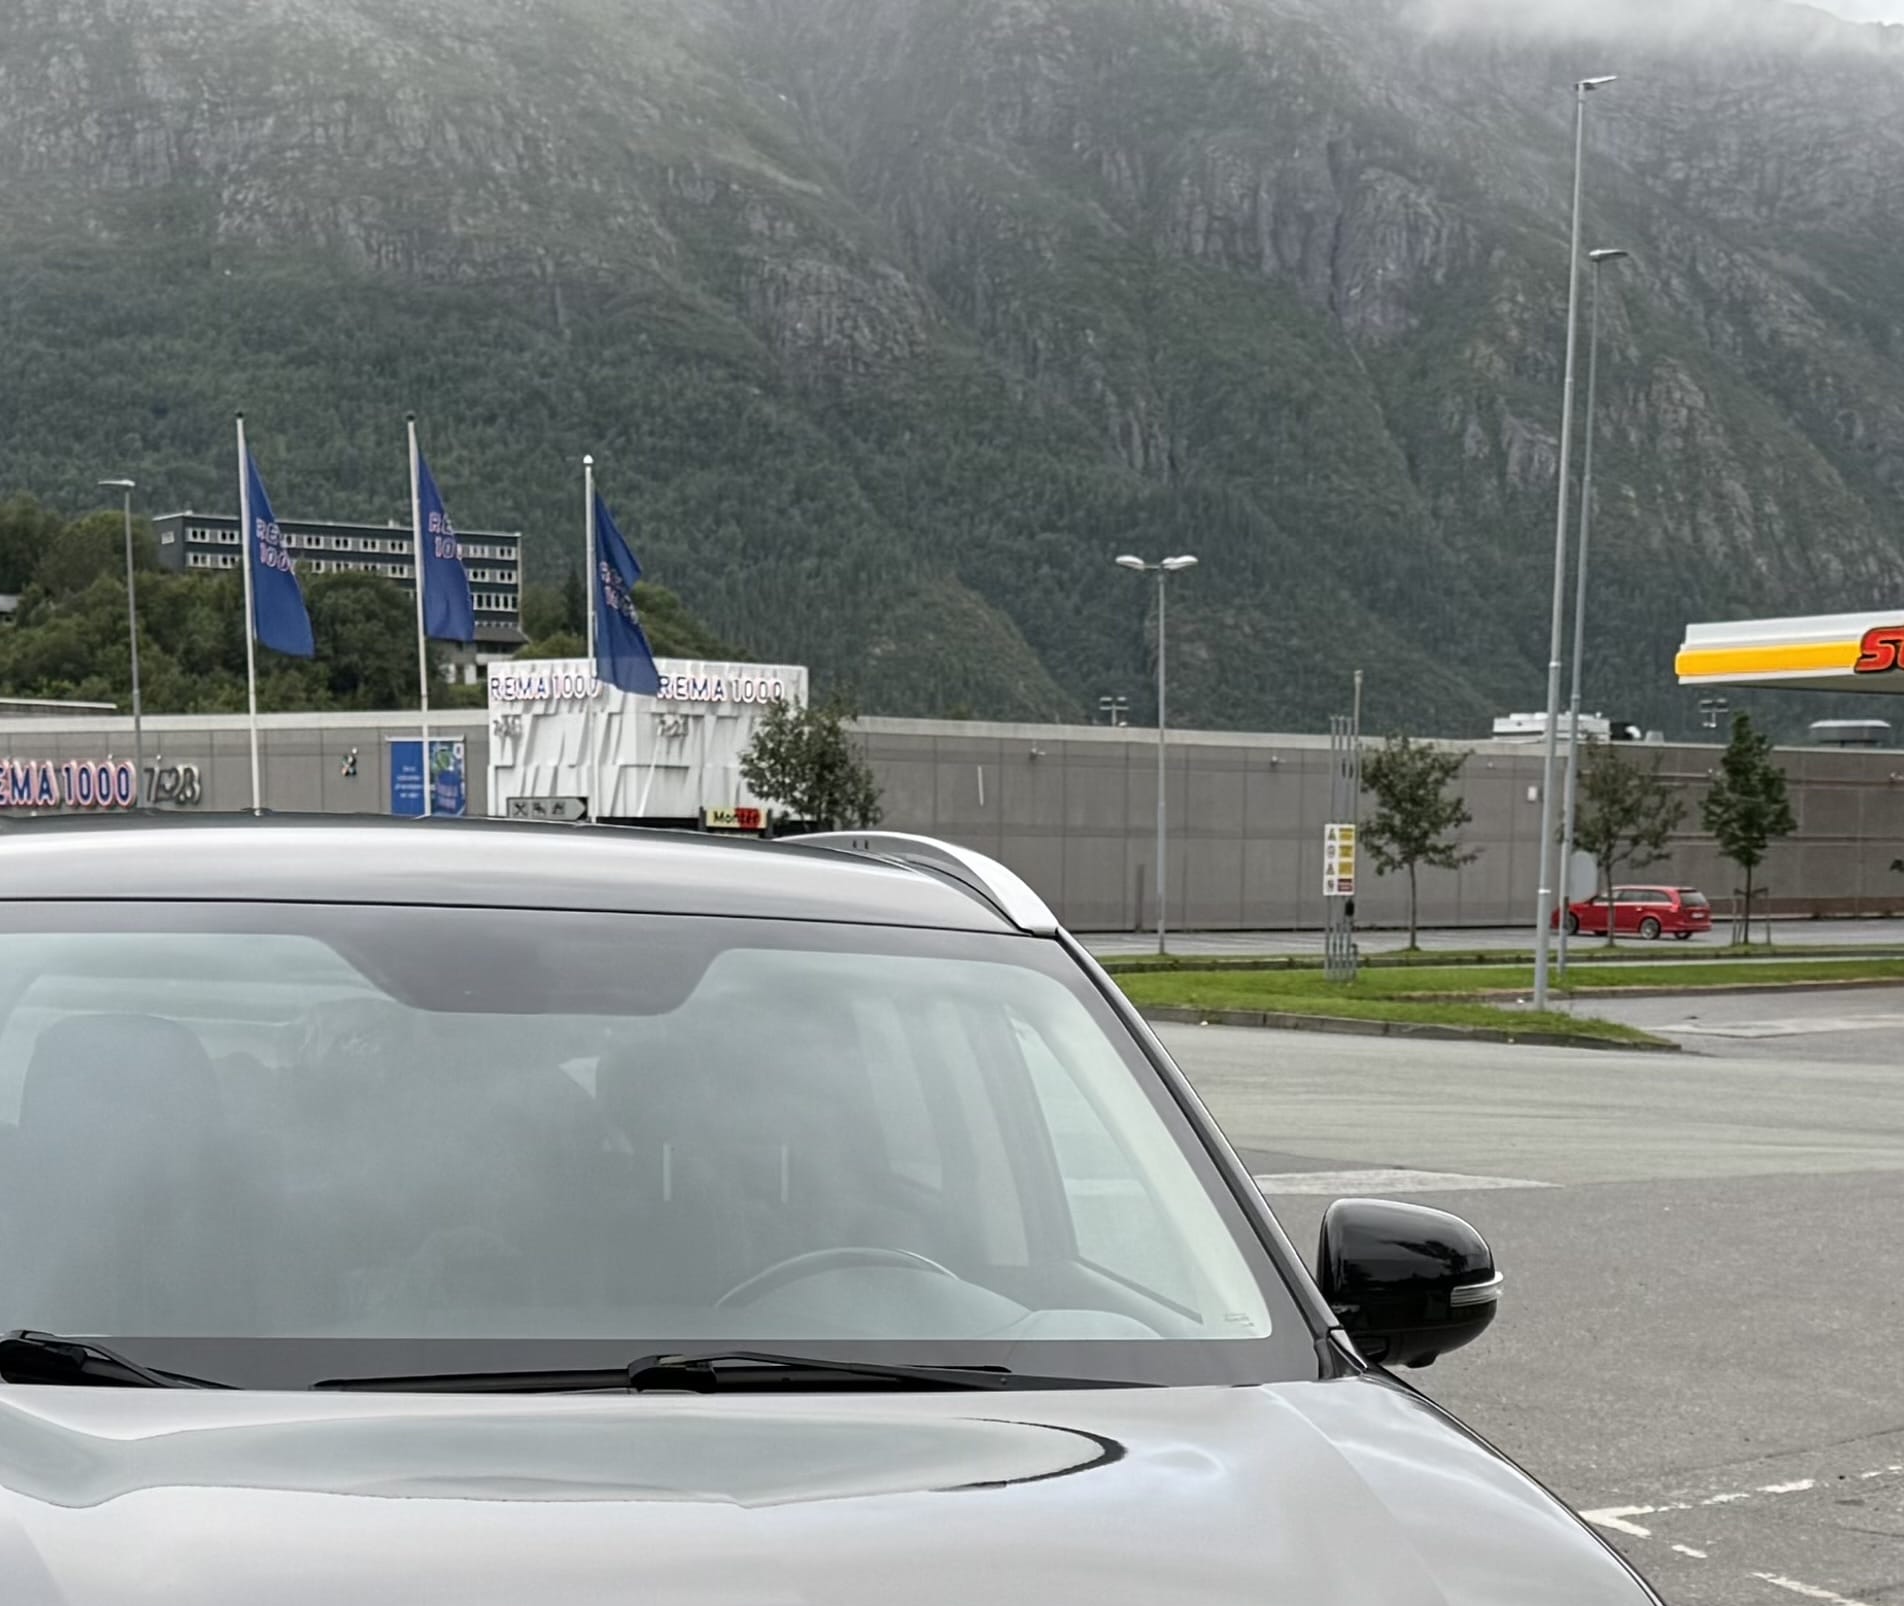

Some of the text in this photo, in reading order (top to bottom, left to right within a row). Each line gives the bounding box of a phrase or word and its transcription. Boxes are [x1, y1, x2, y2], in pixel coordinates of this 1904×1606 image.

[490, 673, 548, 700] REMA
[657, 673, 784, 704] REMA 1000
[62, 760, 138, 806] 1000
